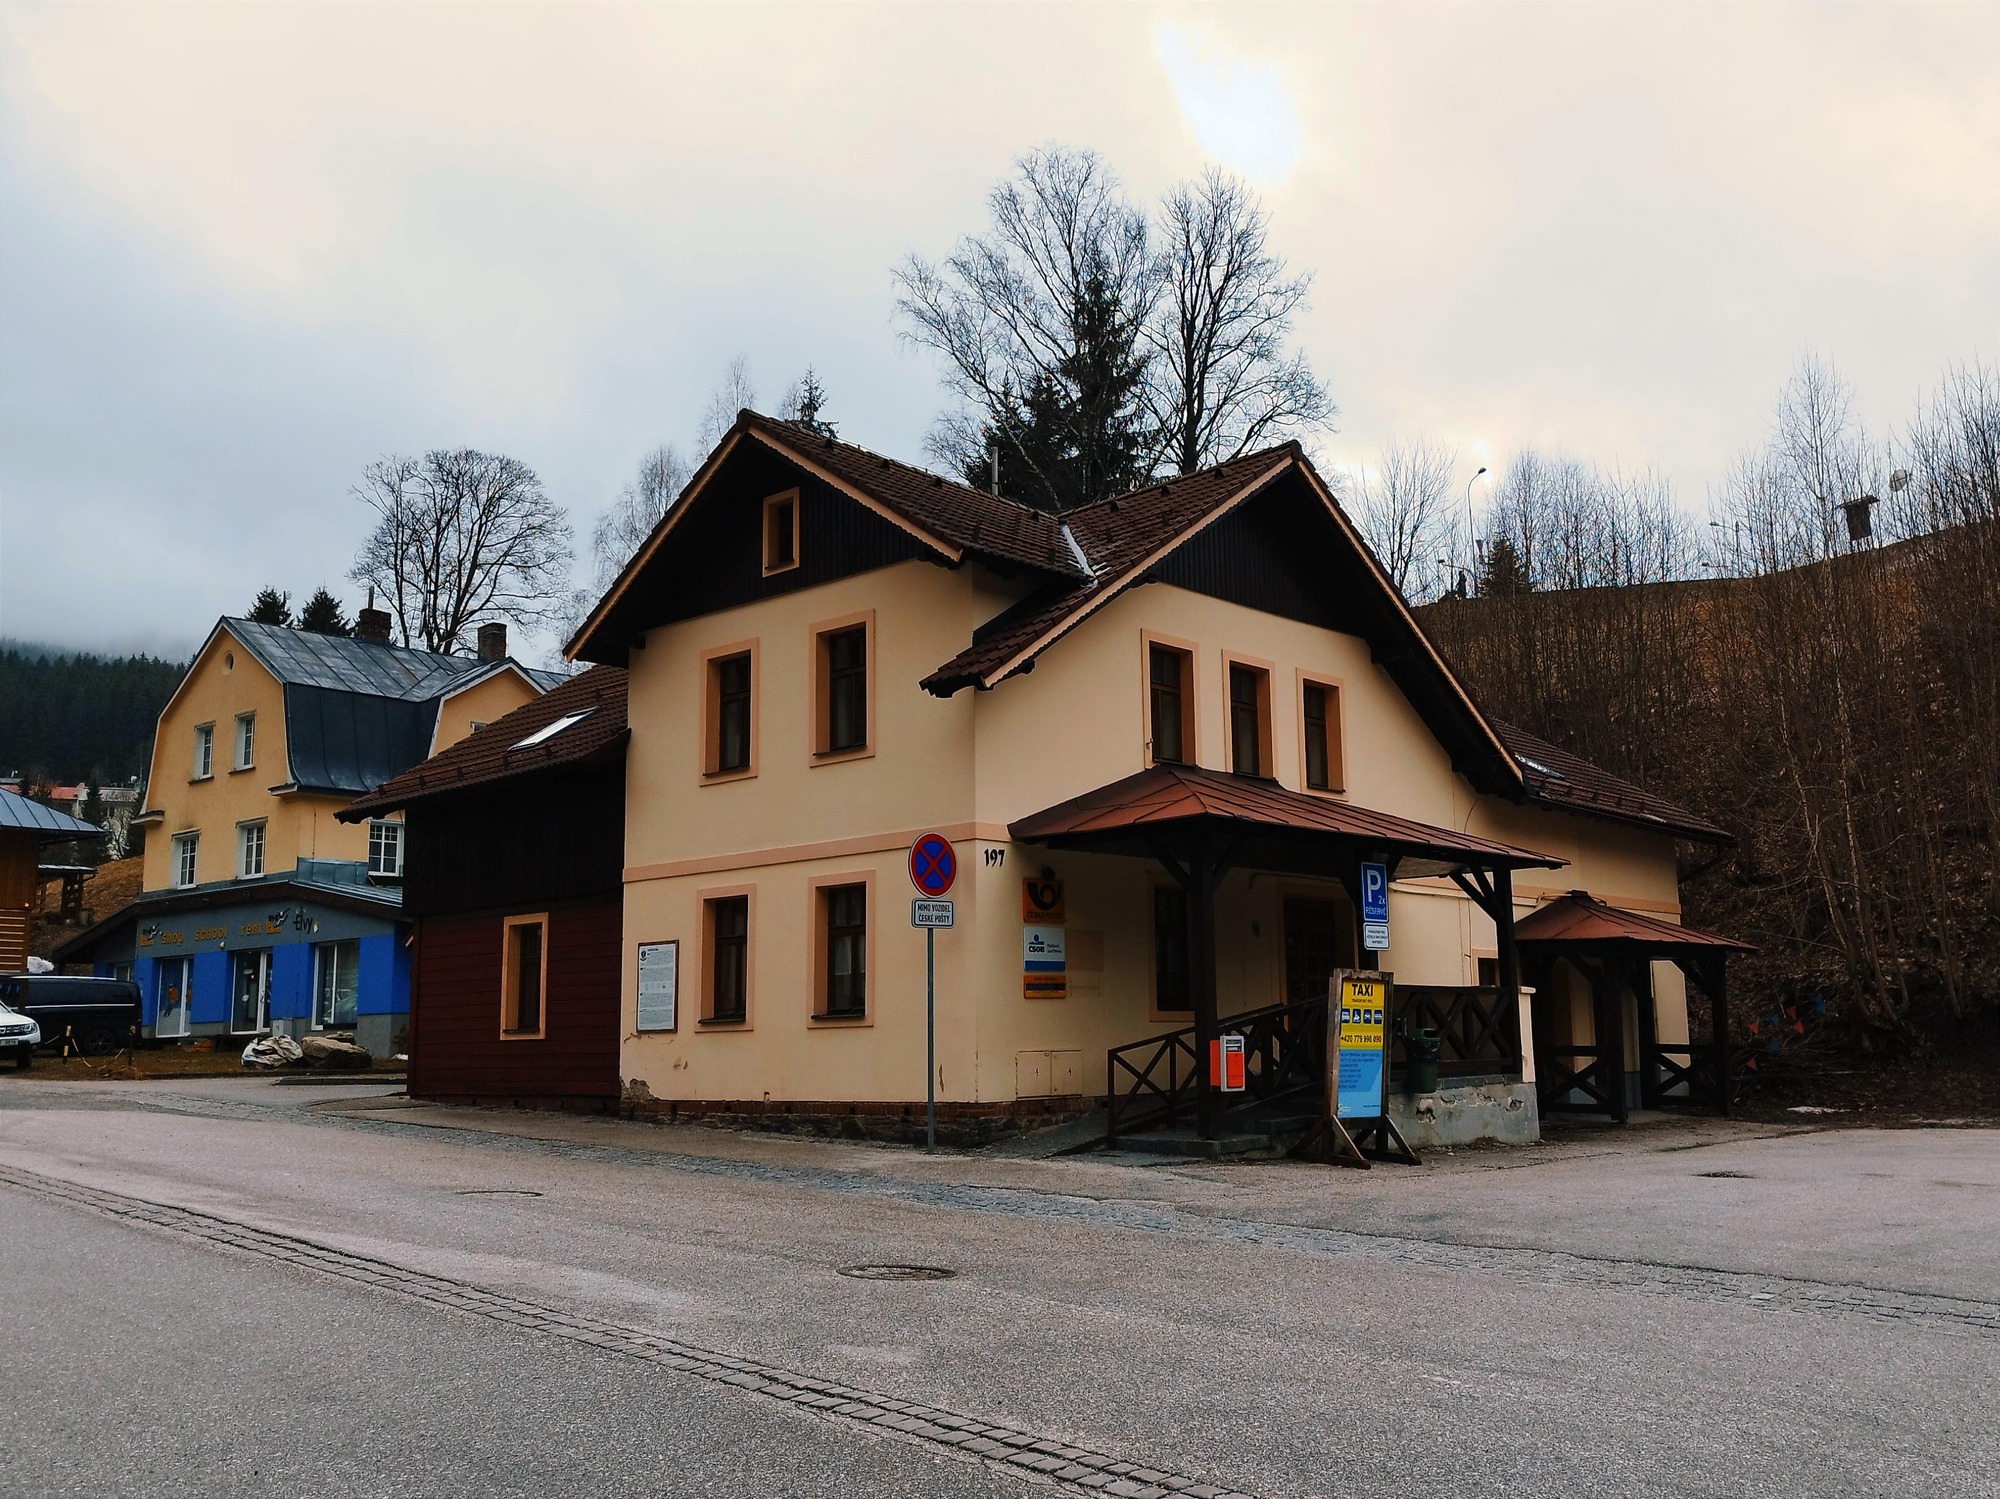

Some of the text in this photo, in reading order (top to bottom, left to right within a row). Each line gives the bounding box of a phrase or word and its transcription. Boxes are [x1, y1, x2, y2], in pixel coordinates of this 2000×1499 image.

[984, 848, 1005, 867] 197
[1367, 869, 1381, 902] P
[917, 903, 951, 912] MIMO VOZIDEL
[918, 913, 950, 923] ČESKÉ POŠTY
[162, 931, 183, 947] shop
[195, 924, 227, 941] school
[241, 920, 262, 937] rent
[1352, 983, 1374, 997] TAXI
[1341, 1034, 1353, 1043] +420
